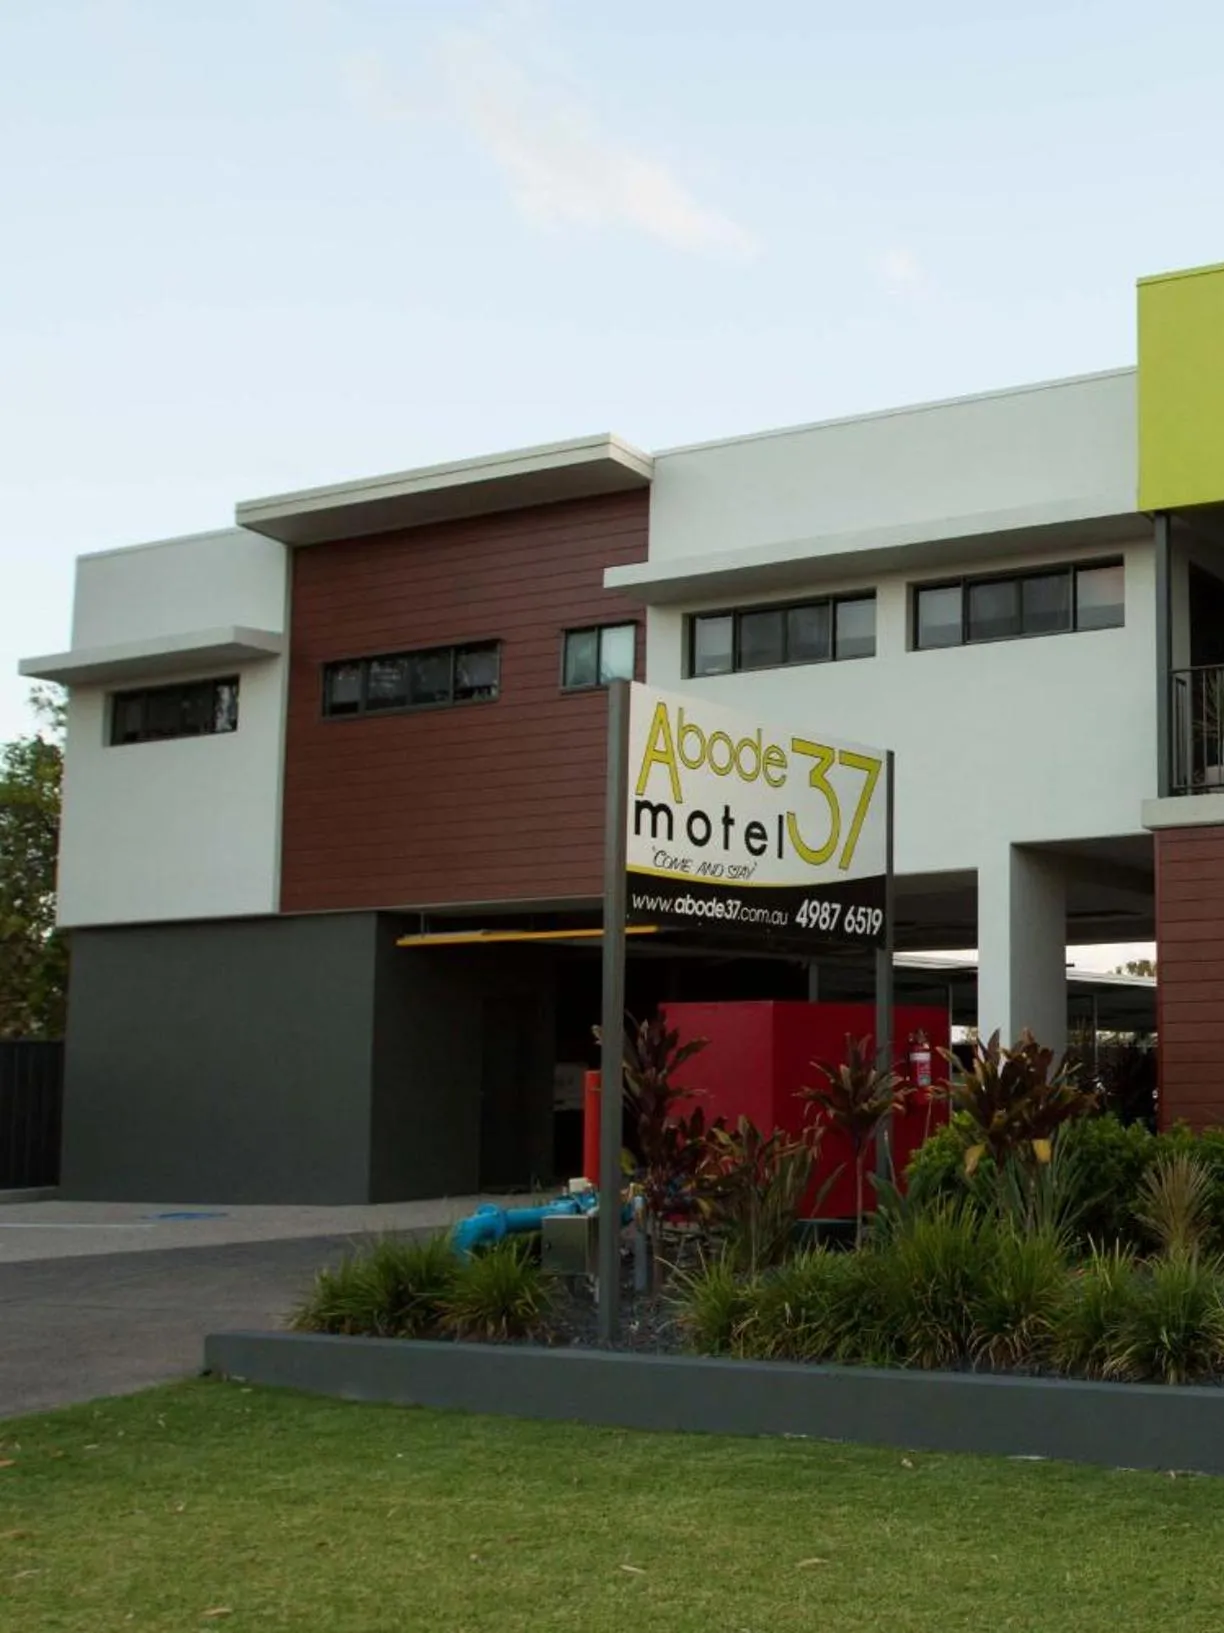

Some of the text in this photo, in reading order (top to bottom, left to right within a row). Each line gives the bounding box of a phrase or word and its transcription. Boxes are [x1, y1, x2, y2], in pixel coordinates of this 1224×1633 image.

[634, 701, 882, 871] Abode 37
[633, 799, 784, 859] motel
[695, 861, 724, 877] AND
[631, 893, 883, 935] www.abode37.com.au 4987 6519
